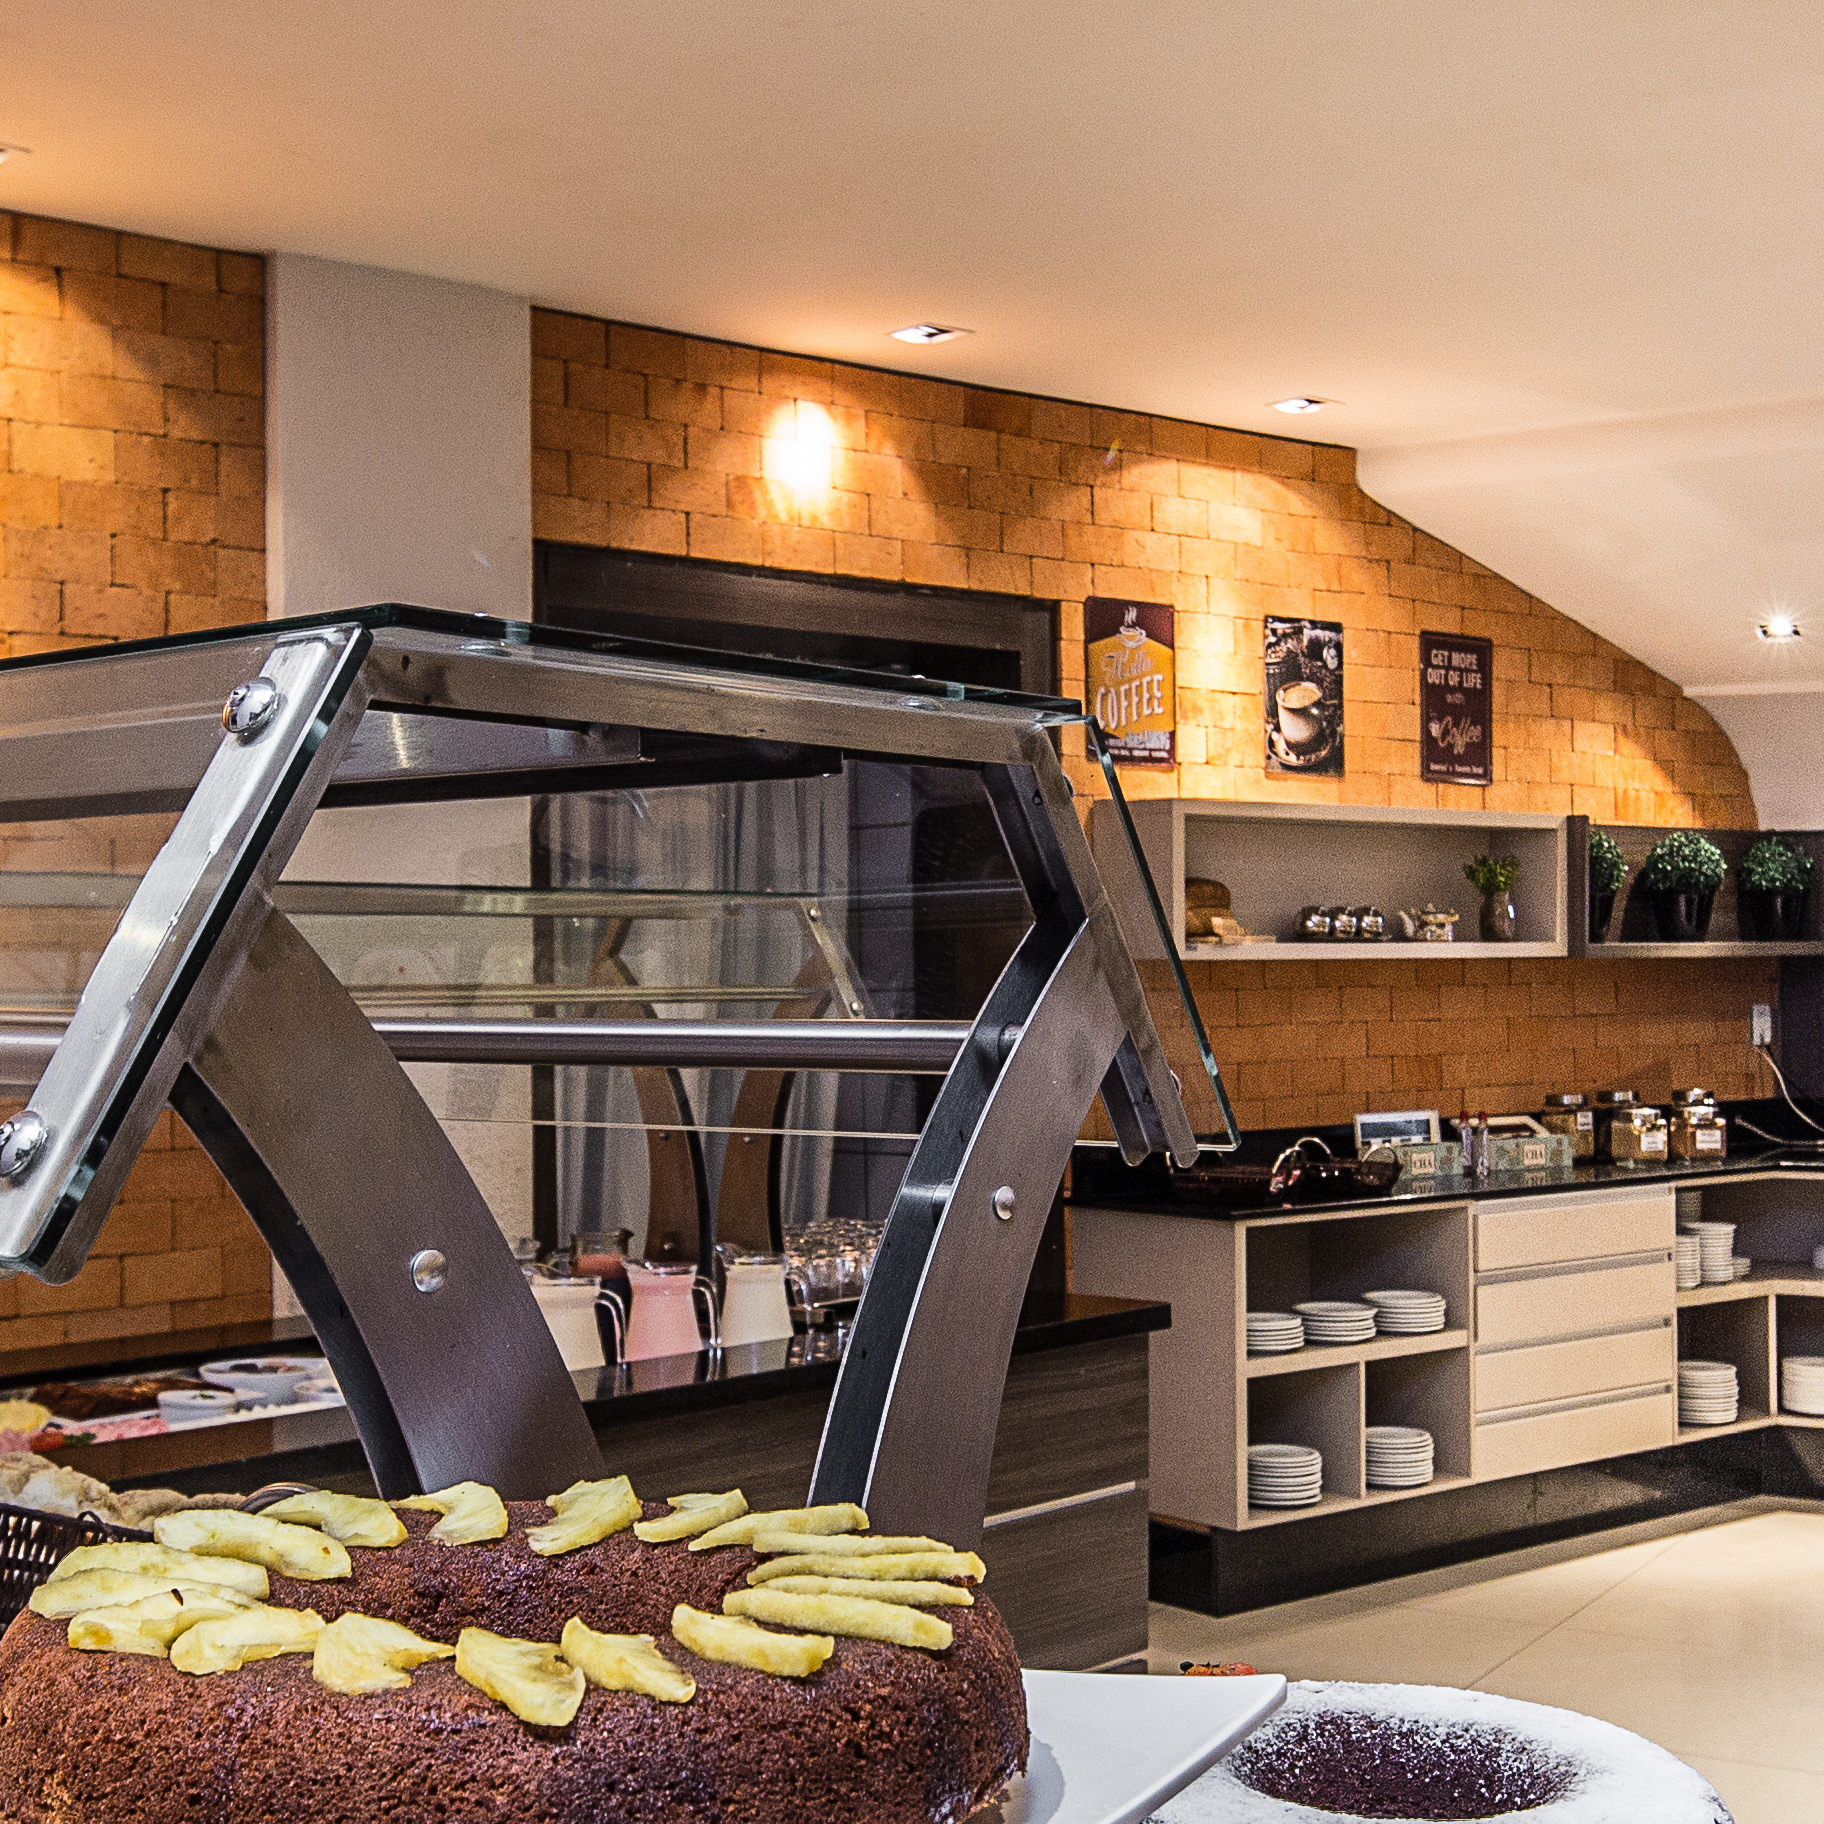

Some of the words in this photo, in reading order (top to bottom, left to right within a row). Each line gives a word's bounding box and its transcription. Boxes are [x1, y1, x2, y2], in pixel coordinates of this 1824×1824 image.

[1431, 649, 1449, 666] GET
[1451, 652, 1478, 670] MORE
[1427, 667, 1446, 685] OUT
[1448, 670, 1462, 687] OF
[1463, 672, 1483, 689] LIFE
[1096, 674, 1165, 729] COFFEE
[1437, 716, 1482, 755] Coffee
